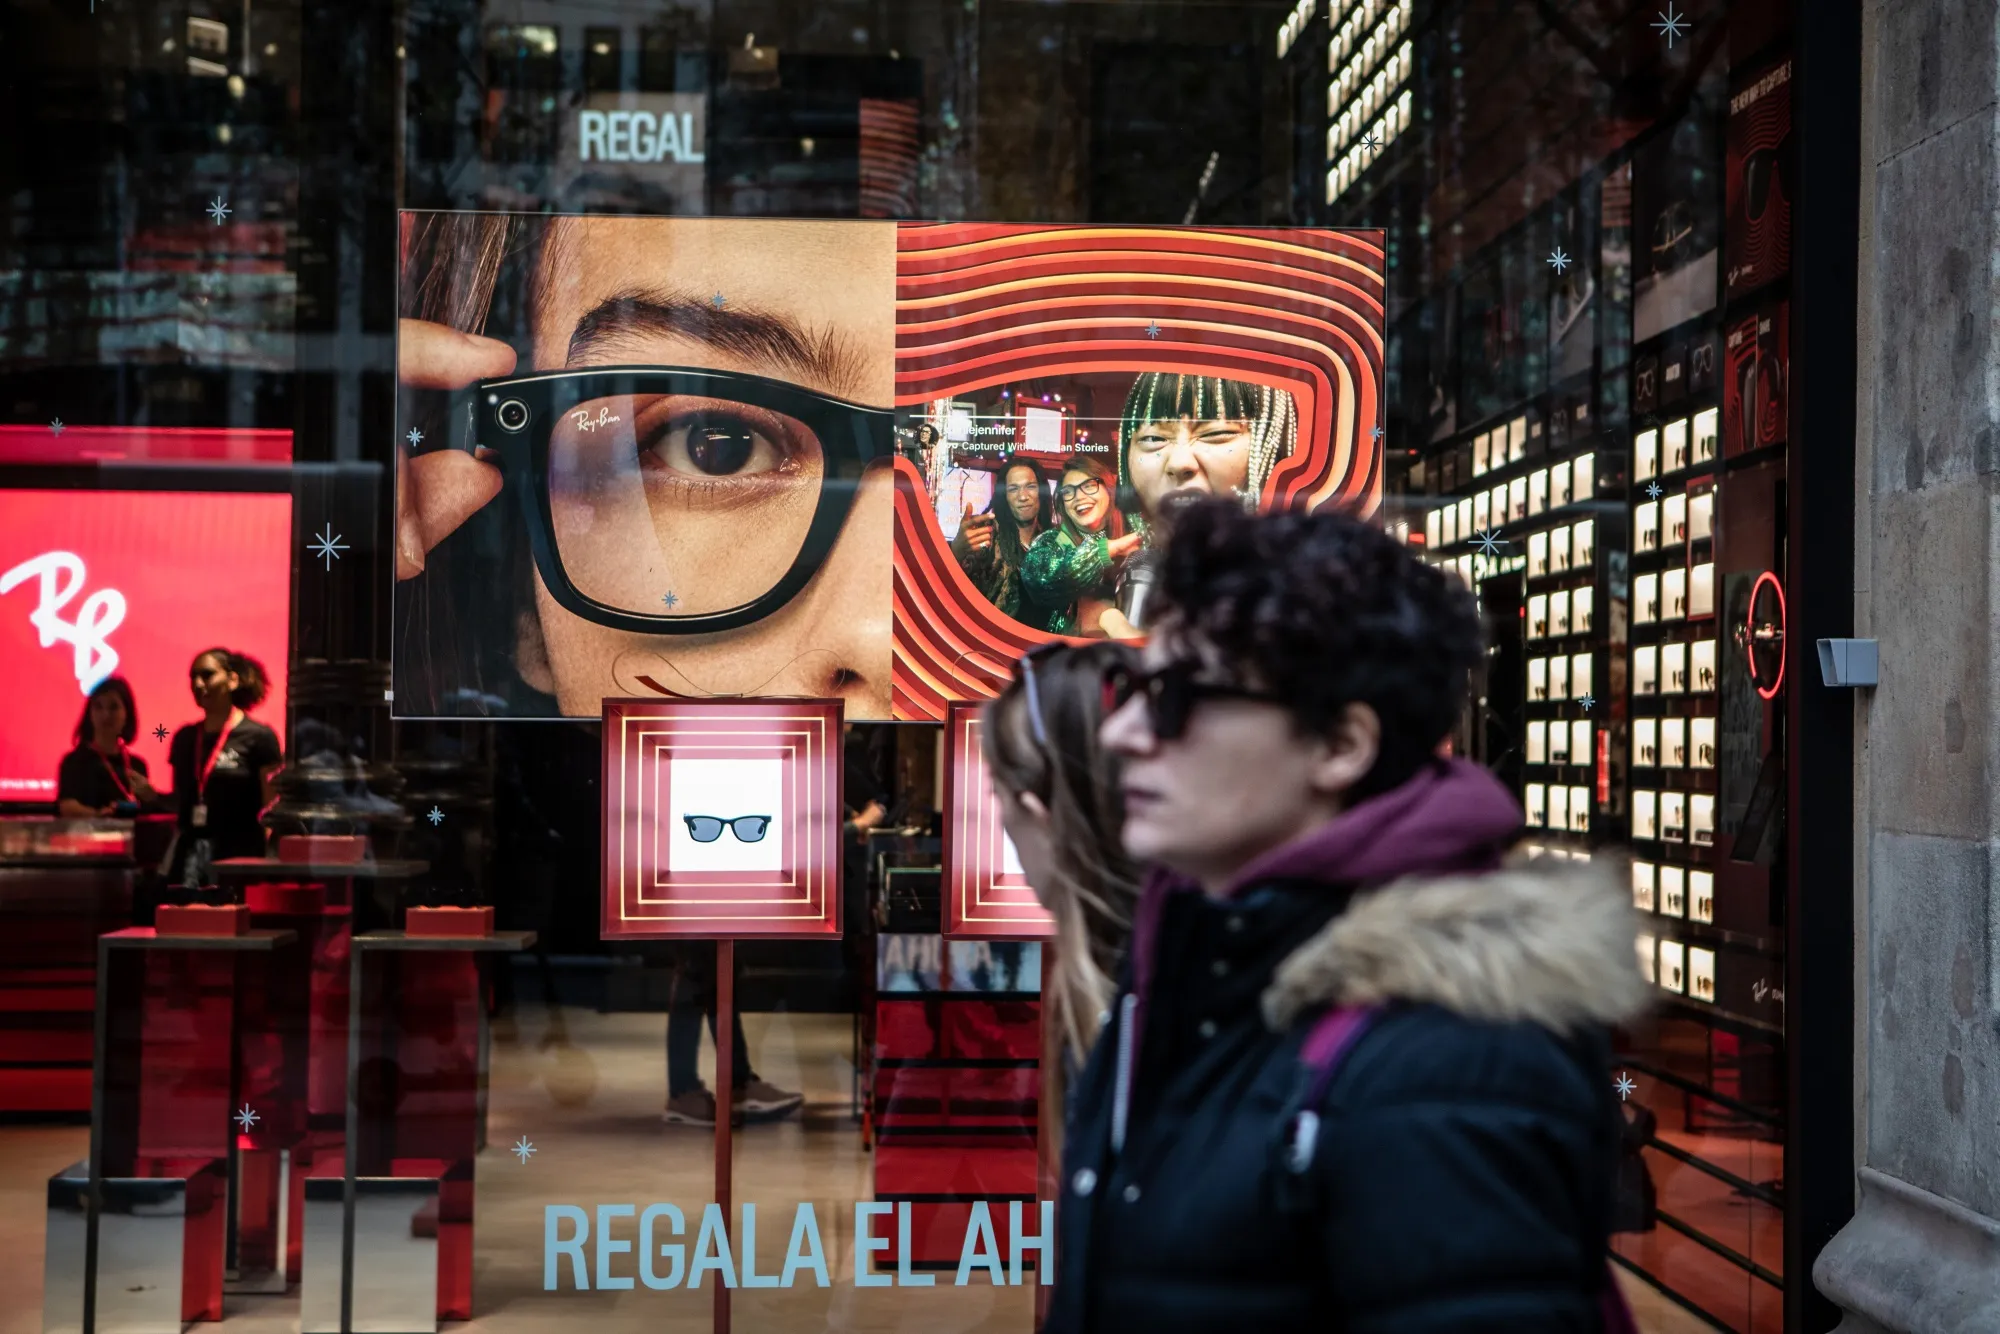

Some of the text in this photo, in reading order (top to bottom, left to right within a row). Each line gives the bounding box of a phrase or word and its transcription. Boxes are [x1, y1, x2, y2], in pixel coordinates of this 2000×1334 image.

[579, 110, 705, 163] REGAL
[961, 441, 1005, 452] Captured
[1074, 442, 1109, 453] Stories
[544, 1200, 1054, 1291] REGALA EL AH
